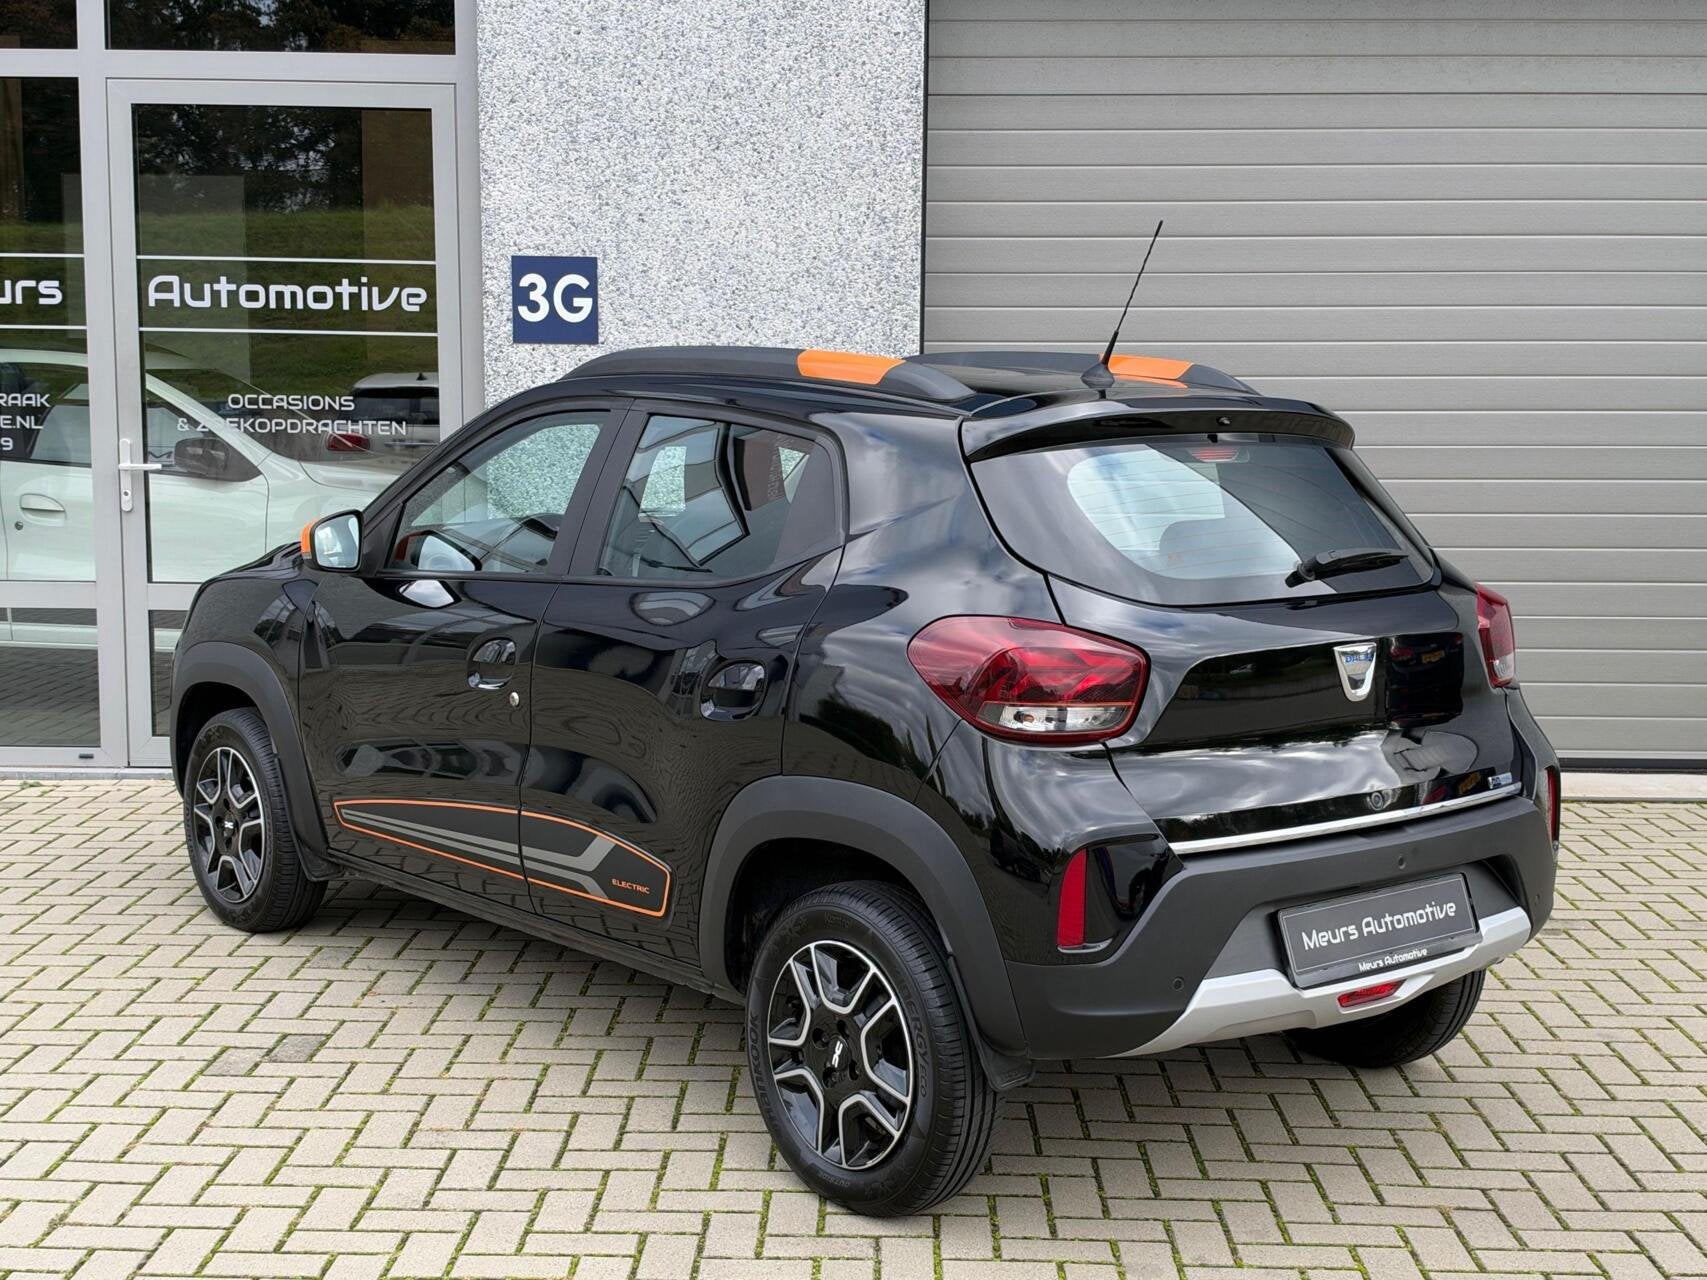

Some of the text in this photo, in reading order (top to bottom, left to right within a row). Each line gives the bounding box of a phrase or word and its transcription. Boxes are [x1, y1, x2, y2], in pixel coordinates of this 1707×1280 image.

[148, 275, 427, 312] Automotive
[518, 273, 593, 323] 3G
[228, 393, 355, 411] OCCASIONS
[177, 417, 406, 436] & ZEKOPDRACHTEN
[611, 878, 651, 894] ELECTRIC
[1301, 901, 1456, 950] Meurs Automotive
[1358, 947, 1428, 972] Meurs Automotive
